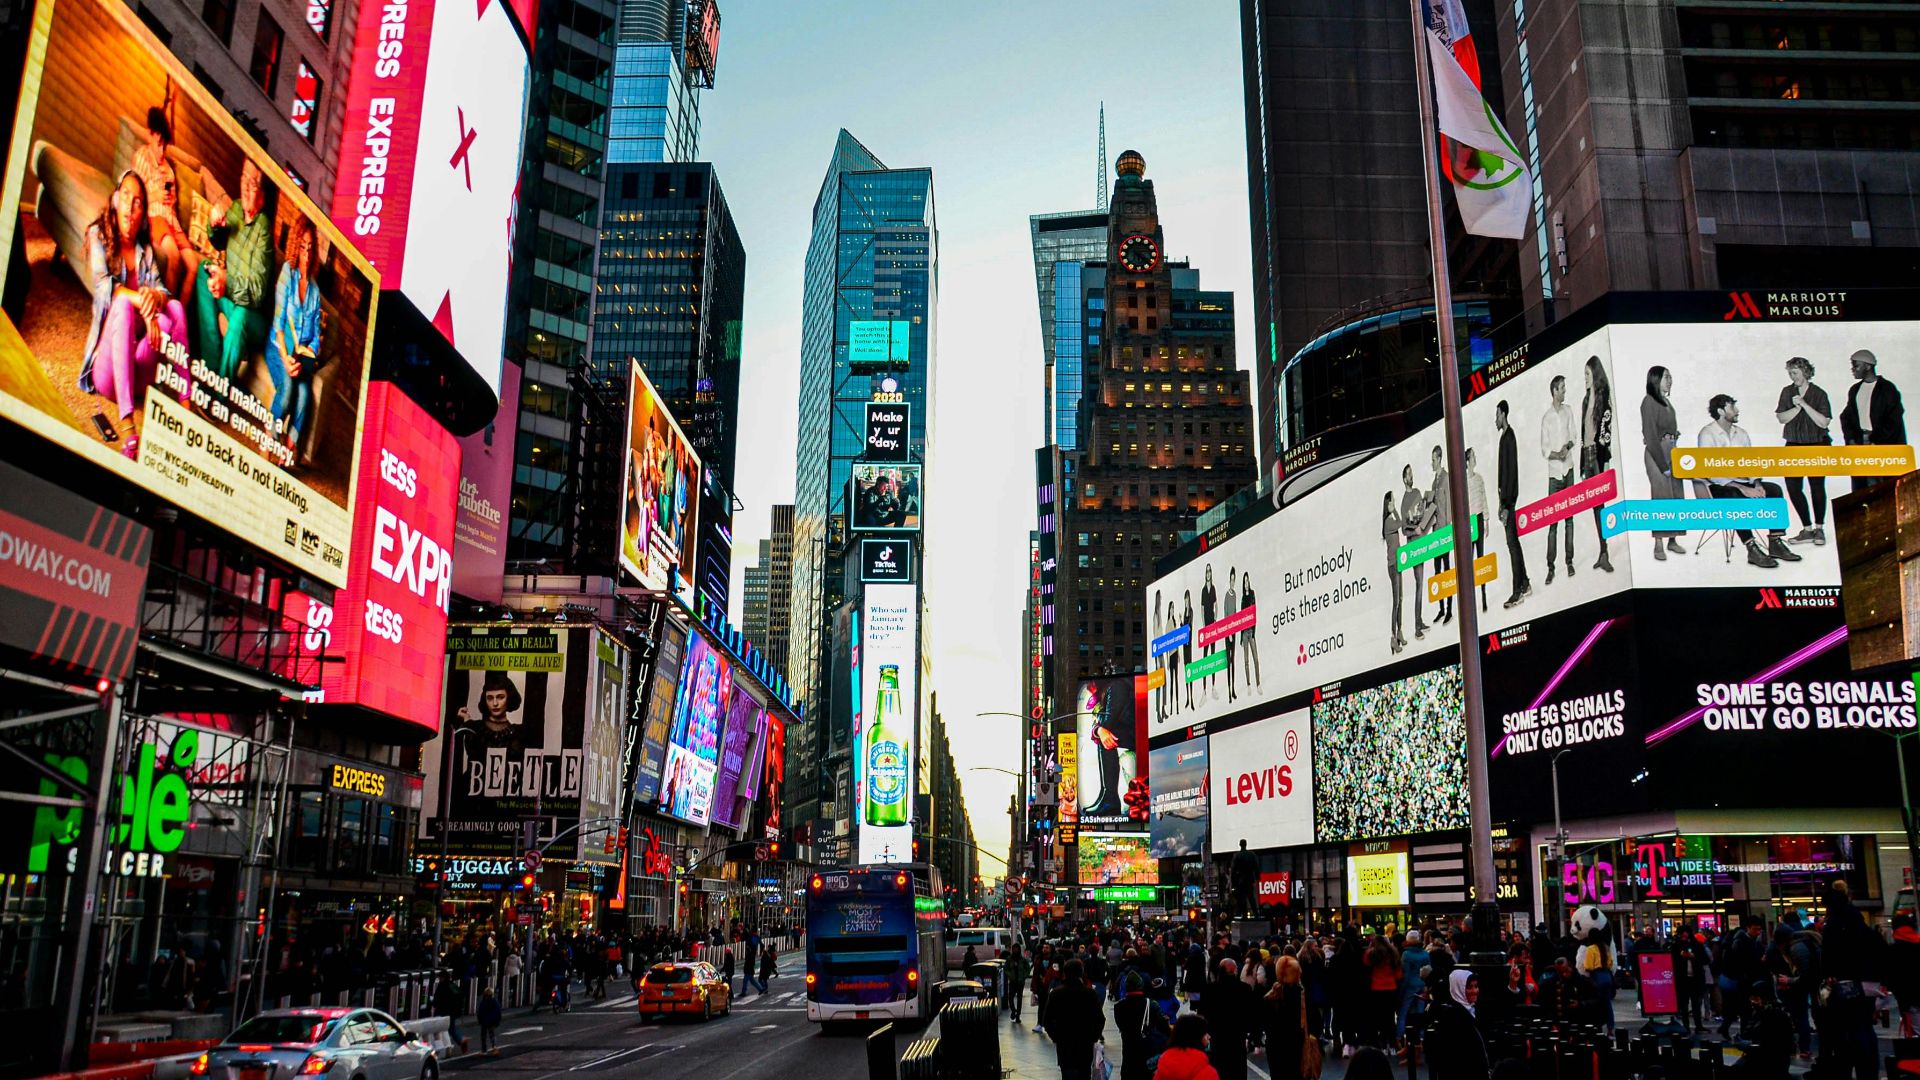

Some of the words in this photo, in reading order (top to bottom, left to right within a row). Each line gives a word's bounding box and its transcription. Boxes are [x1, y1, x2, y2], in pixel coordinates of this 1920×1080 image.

[354, 97, 395, 236] EXPRESS
[1767, 292, 1848, 303] MARRIOTT
[1769, 305, 1840, 316] MARQUIS
[1488, 343, 1530, 374] MARRIOTT
[1488, 358, 1526, 386] MARQUIS
[160, 331, 189, 369] Talk
[191, 352, 229, 397] about
[230, 385, 274, 430] making
[275, 418, 284, 434] a
[874, 392, 903, 403] 2020
[156, 362, 188, 397] plan
[190, 380, 211, 410] for
[212, 400, 230, 423] an
[230, 412, 295, 467] emergency.
[872, 412, 904, 422] Make
[874, 427, 881, 437] y
[888, 427, 900, 435] ur
[147, 440, 164, 457] VISIT
[151, 400, 183, 437] Then
[187, 428, 203, 448] go
[206, 434, 235, 468] back
[238, 454, 249, 476] to
[252, 467, 271, 489] not
[273, 479, 309, 513] talking.
[1285, 437, 1321, 462] MARRIOTT
[144, 455, 156, 470] OR
[157, 462, 174, 480] CALL
[1285, 451, 1317, 474] MARQUIS
[1704, 456, 1734, 468] Make
[1737, 456, 1776, 469] design
[1778, 455, 1837, 467] accessible
[1840, 456, 1852, 466] to
[1854, 456, 1907, 468] everyone
[1531, 509, 1544, 523] Sell
[1544, 505, 1554, 518] tile
[1554, 500, 1568, 515] that
[1568, 493, 1585, 511] lasts
[1585, 481, 1612, 505] forever
[1621, 509, 1650, 522] Write
[1652, 511, 1677, 521] new
[1678, 509, 1723, 522] product
[1726, 510, 1753, 522] spec
[1756, 508, 1777, 519] doc
[302, 528, 320, 548] NYC
[1208, 521, 1229, 538] MARRIOTT
[1209, 531, 1227, 547] MARQUIS
[1409, 545, 1428, 558] Partner
[1428, 541, 1439, 551] with
[1284, 569, 1304, 593] But
[1306, 545, 1353, 580] nobody
[1785, 588, 1840, 597] MARRIOTT
[1272, 605, 1296, 635] gets
[1299, 590, 1330, 618] there
[1333, 577, 1372, 605] alone.
[1786, 598, 1836, 607] MARQUIS
[872, 615, 904, 623] January
[1501, 624, 1530, 638] MARRIOTT
[466, 637, 500, 651] SQUARE
[502, 637, 519, 649] CAN
[522, 637, 554, 650] REALLY
[1308, 632, 1344, 659] asana
[1501, 633, 1528, 648] MARQUIS
[459, 655, 485, 667] MAKE
[487, 655, 505, 667] YOU
[508, 656, 529, 668] FEEL
[532, 657, 561, 669] ALIVE!
[737, 632, 793, 710] BROADWAY
[1322, 682, 1342, 692] MARRIOTT
[1322, 689, 1340, 699] MARQUIS
[1696, 683, 1765, 706] SOME
[1771, 682, 1803, 705] 5G
[1808, 681, 1916, 704] SIGNALS
[1502, 706, 1539, 735] SOME
[1540, 702, 1559, 726] 5G
[1560, 689, 1625, 722] SIGNALS
[1703, 707, 1769, 731] ONLY
[1772, 707, 1812, 730] GO
[1816, 706, 1917, 729] BLOCKS
[1506, 728, 1539, 756] ONLY
[1541, 726, 1563, 748] GO
[1564, 714, 1625, 744] BLOCKS
[1061, 747, 1074, 755] LION
[1060, 756, 1075, 764] KING
[332, 764, 385, 797] EXPRESS
[468, 753, 581, 798] BEETLE
[1156, 794, 1165, 803] WITH
[1170, 790, 1182, 800] AIRLINE
[1183, 788, 1191, 798] THAT
[1191, 786, 1200, 796] FLIES
[1163, 801, 1181, 812] COUNTRIES
[1181, 799, 1189, 808] THAN
[1080, 816, 1129, 824] SASshoes.com
[66, 847, 165, 878] SCER
[1638, 843, 1667, 897] T
[1360, 868, 1395, 881] LEGENDARY
[1563, 861, 1615, 904] 5G
[1626, 874, 1651, 887] FRO
[1362, 883, 1393, 896] HOLIDAYS
[1470, 885, 1519, 898] SORA
[845, 923, 876, 931] FAMILY
